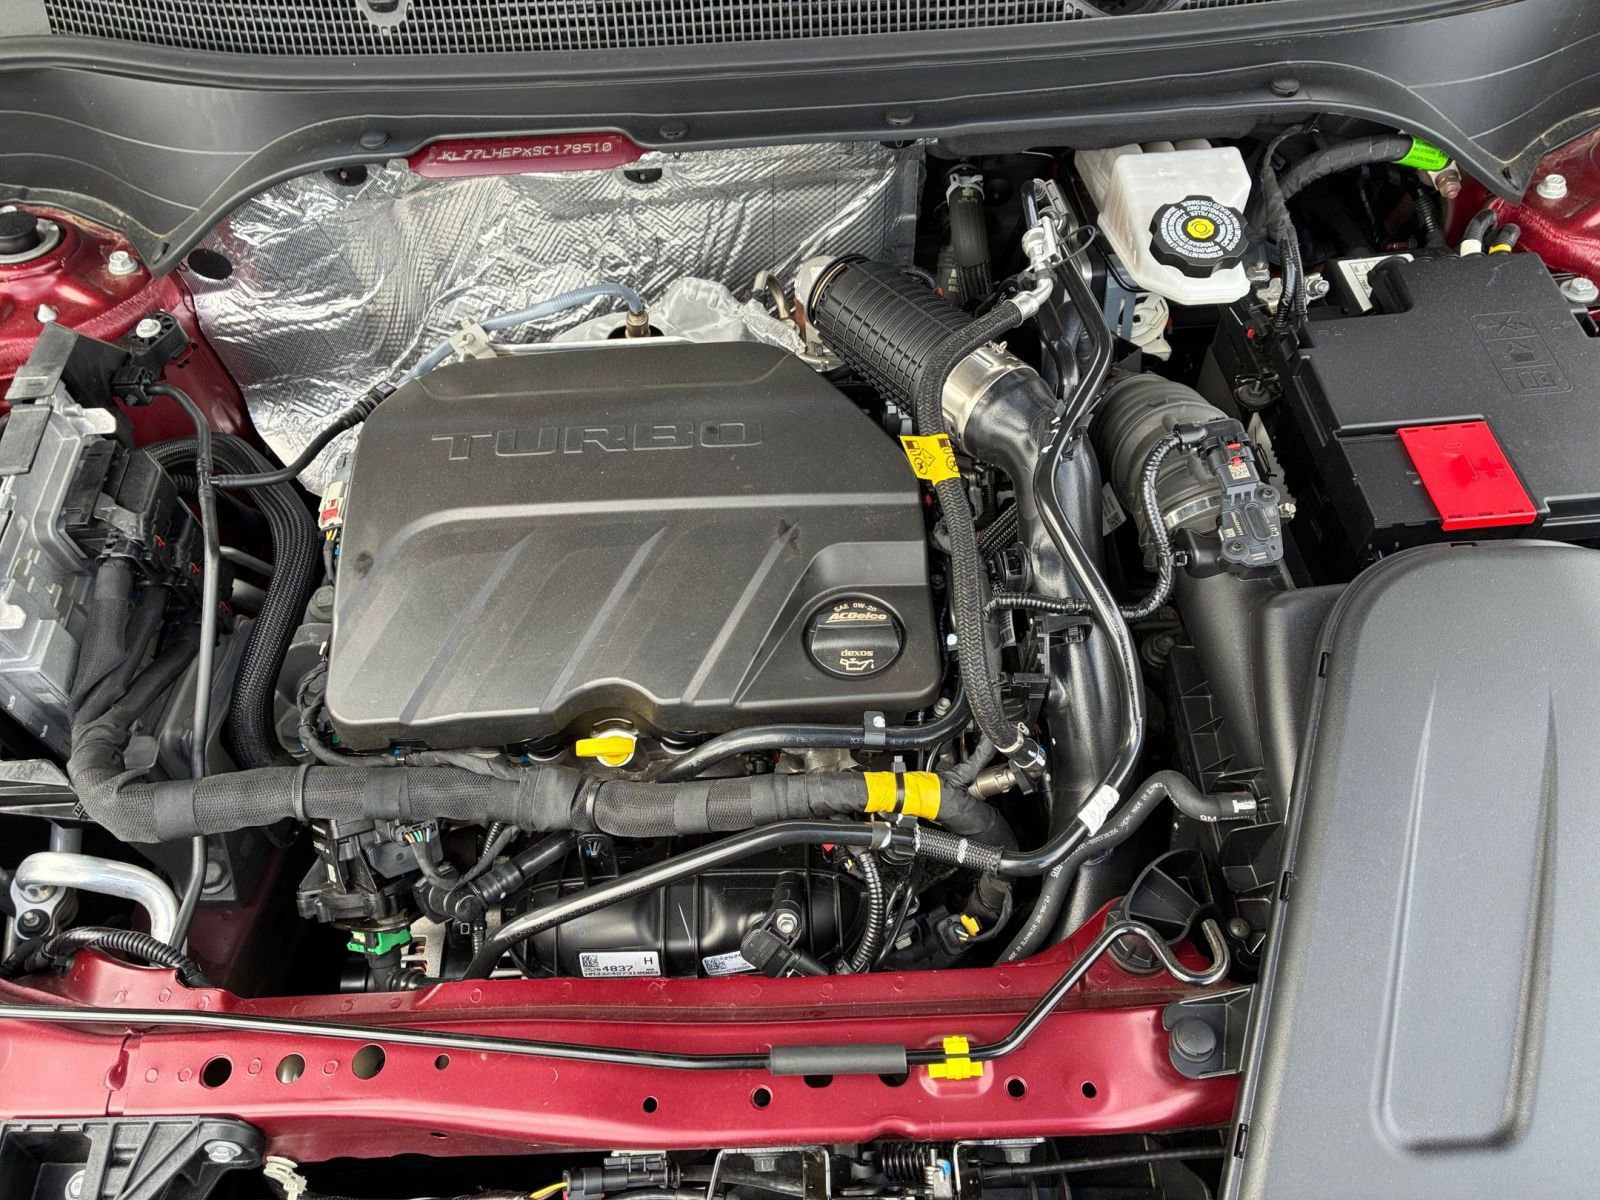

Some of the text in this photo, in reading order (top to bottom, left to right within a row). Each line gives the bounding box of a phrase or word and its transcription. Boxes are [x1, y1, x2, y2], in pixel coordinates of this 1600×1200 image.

[432, 421, 763, 460] TURBO
[833, 603, 850, 612] SAE
[826, 611, 887, 622] ACDelco
[840, 649, 874, 657] dexos
[644, 956, 653, 965] H
